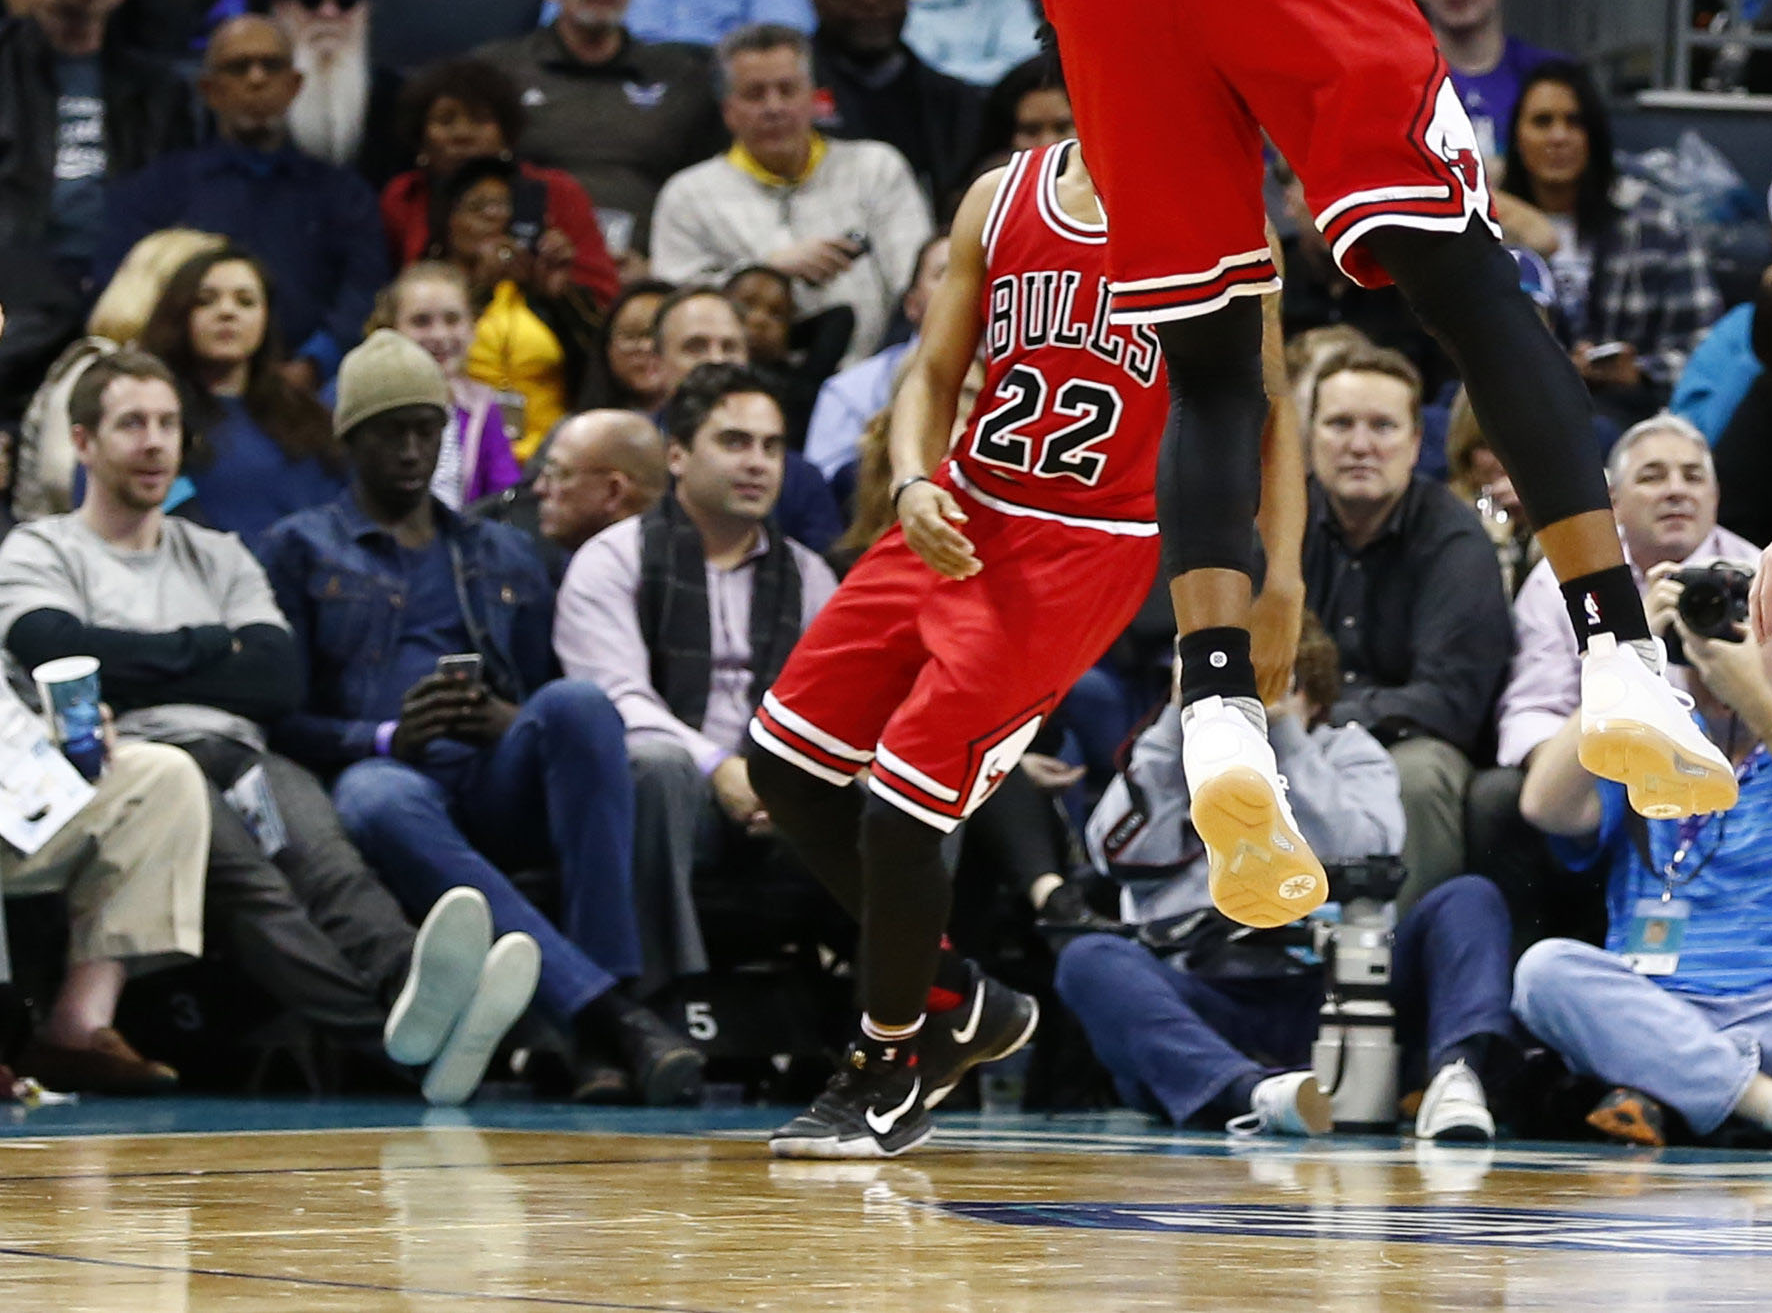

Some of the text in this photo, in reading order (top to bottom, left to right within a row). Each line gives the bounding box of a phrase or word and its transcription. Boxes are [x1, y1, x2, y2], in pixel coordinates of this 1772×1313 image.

[987, 270, 1162, 388] BULLS
[969, 363, 1124, 487] 22
[685, 1001, 718, 1041] 5
